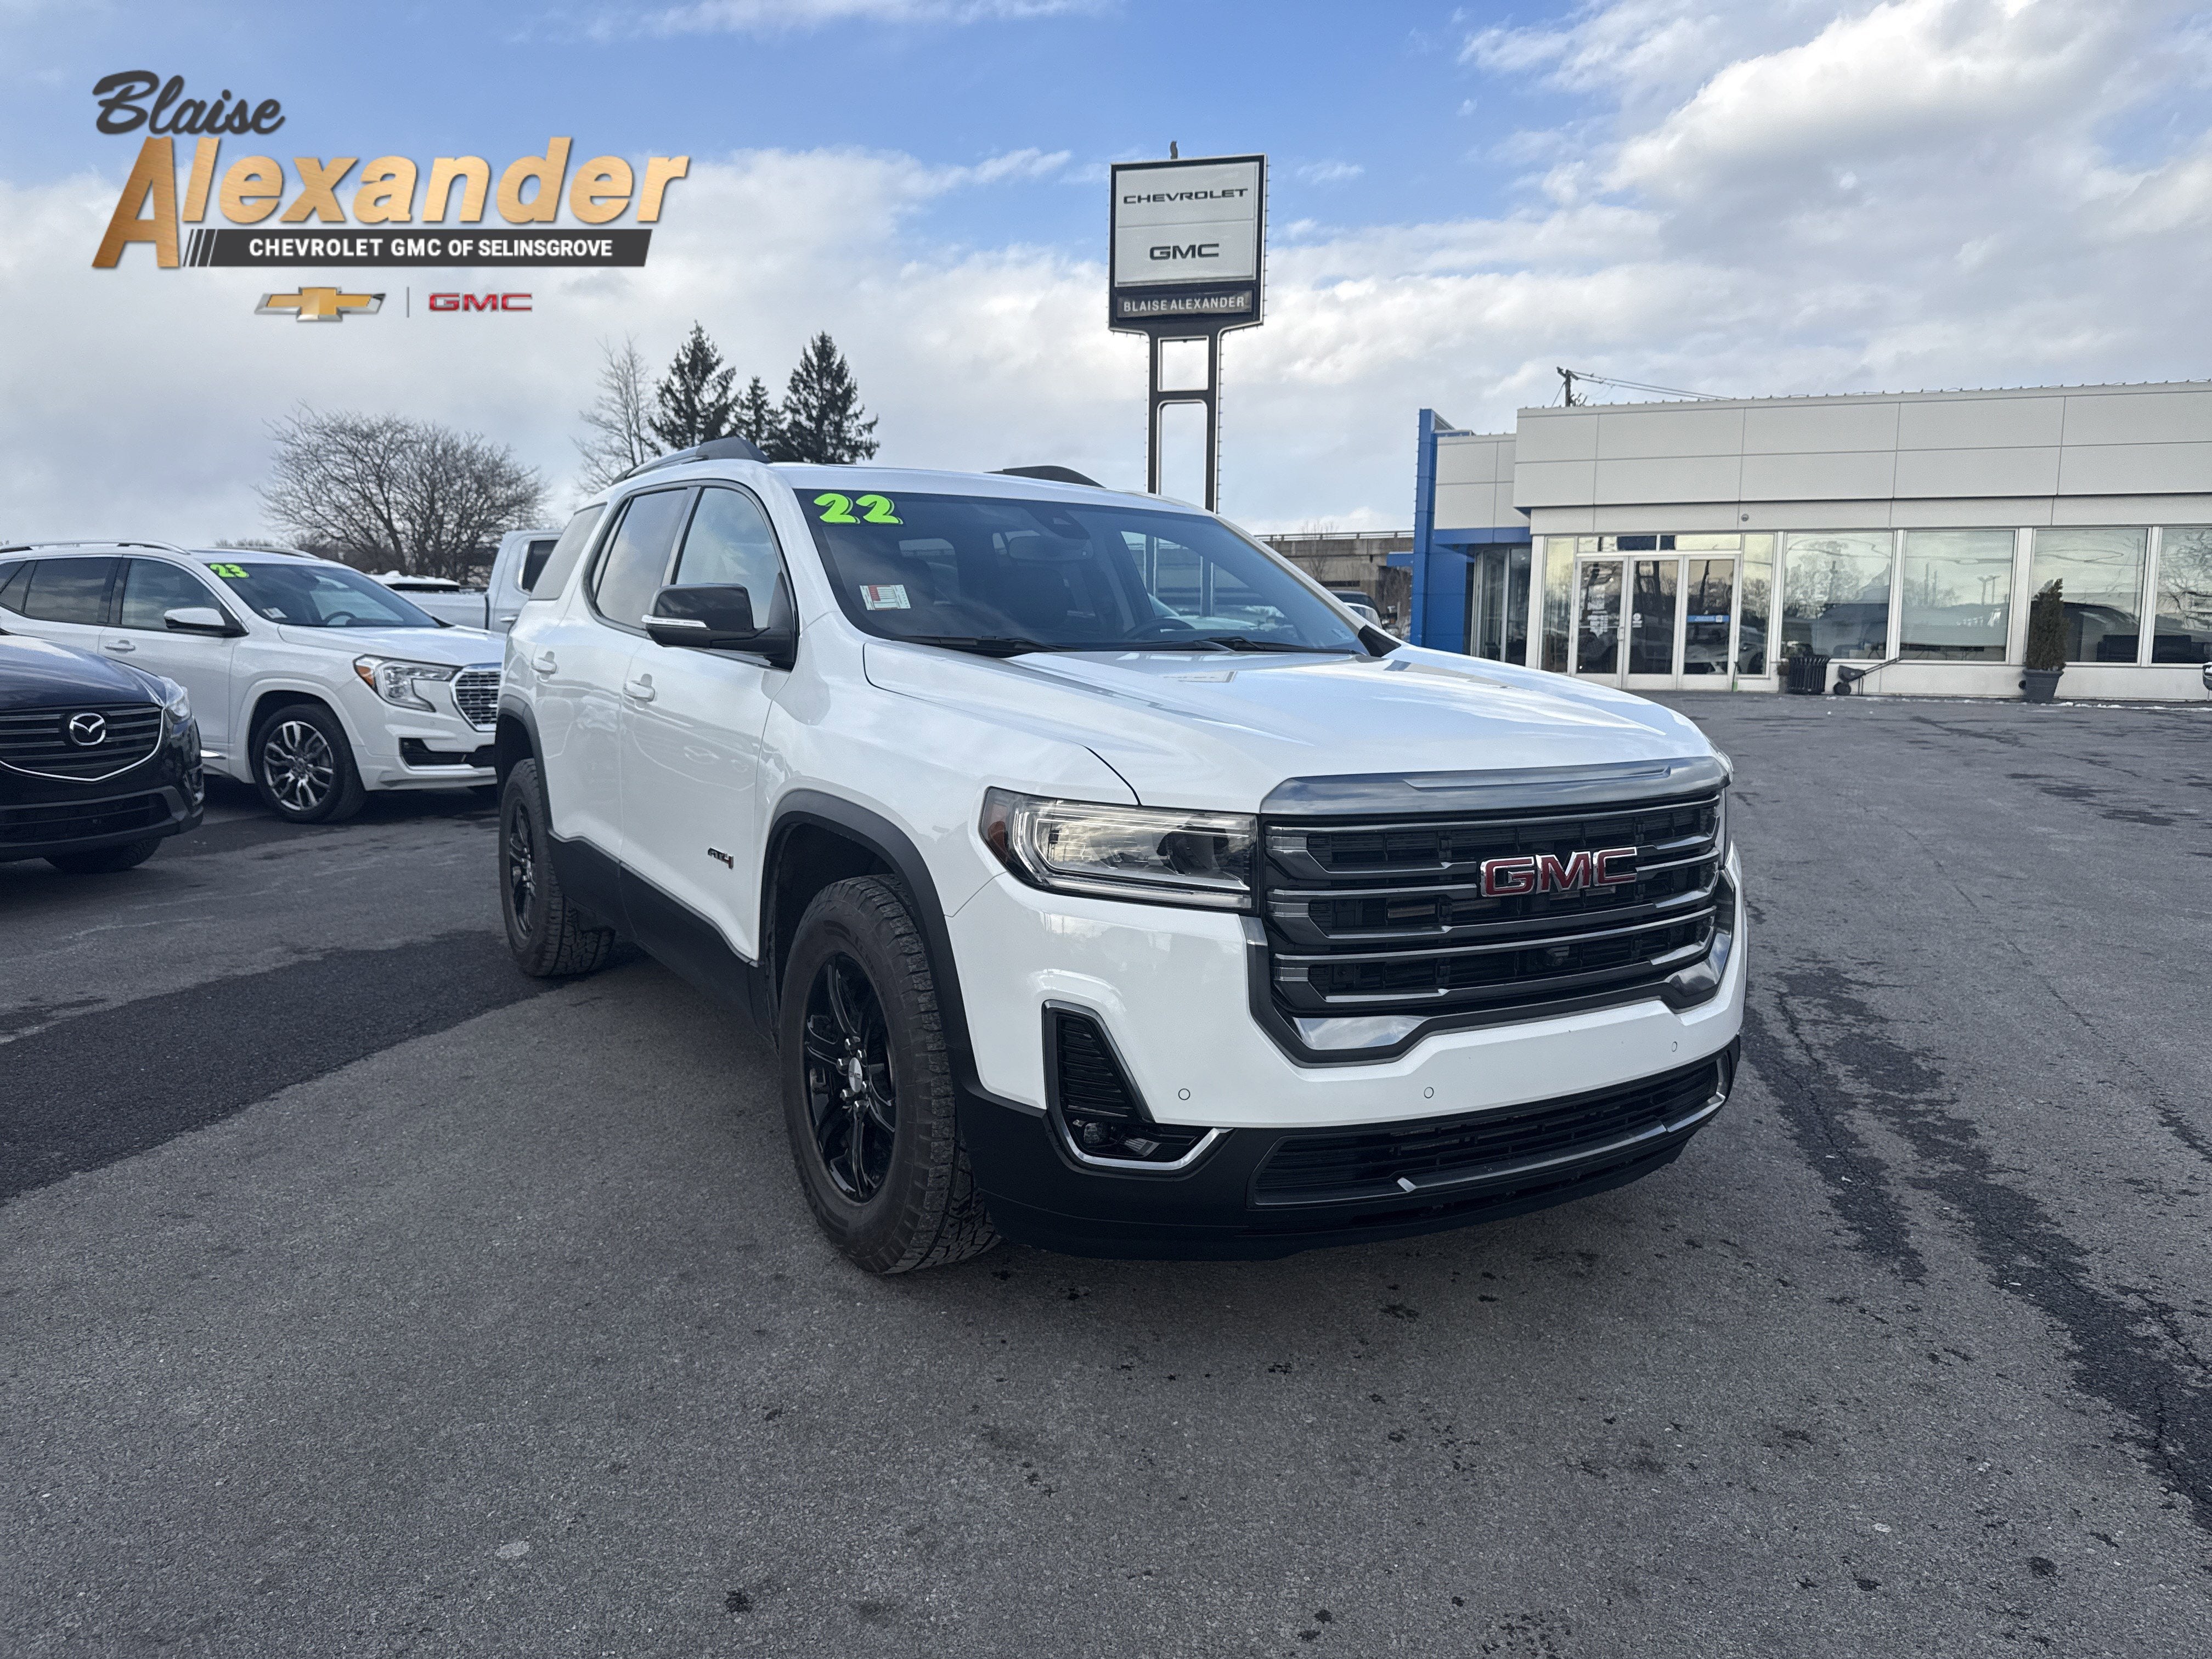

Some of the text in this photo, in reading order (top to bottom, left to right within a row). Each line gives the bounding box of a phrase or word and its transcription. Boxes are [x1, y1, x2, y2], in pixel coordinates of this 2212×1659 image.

[1123, 188, 1249, 204] CHEVROLET
[1149, 243, 1220, 261] GMC
[1123, 296, 1245, 312] BLAISE ALEXANDER
[813, 493, 904, 525] 22
[210, 563, 250, 578] 23
[1480, 847, 1638, 898] GMC
